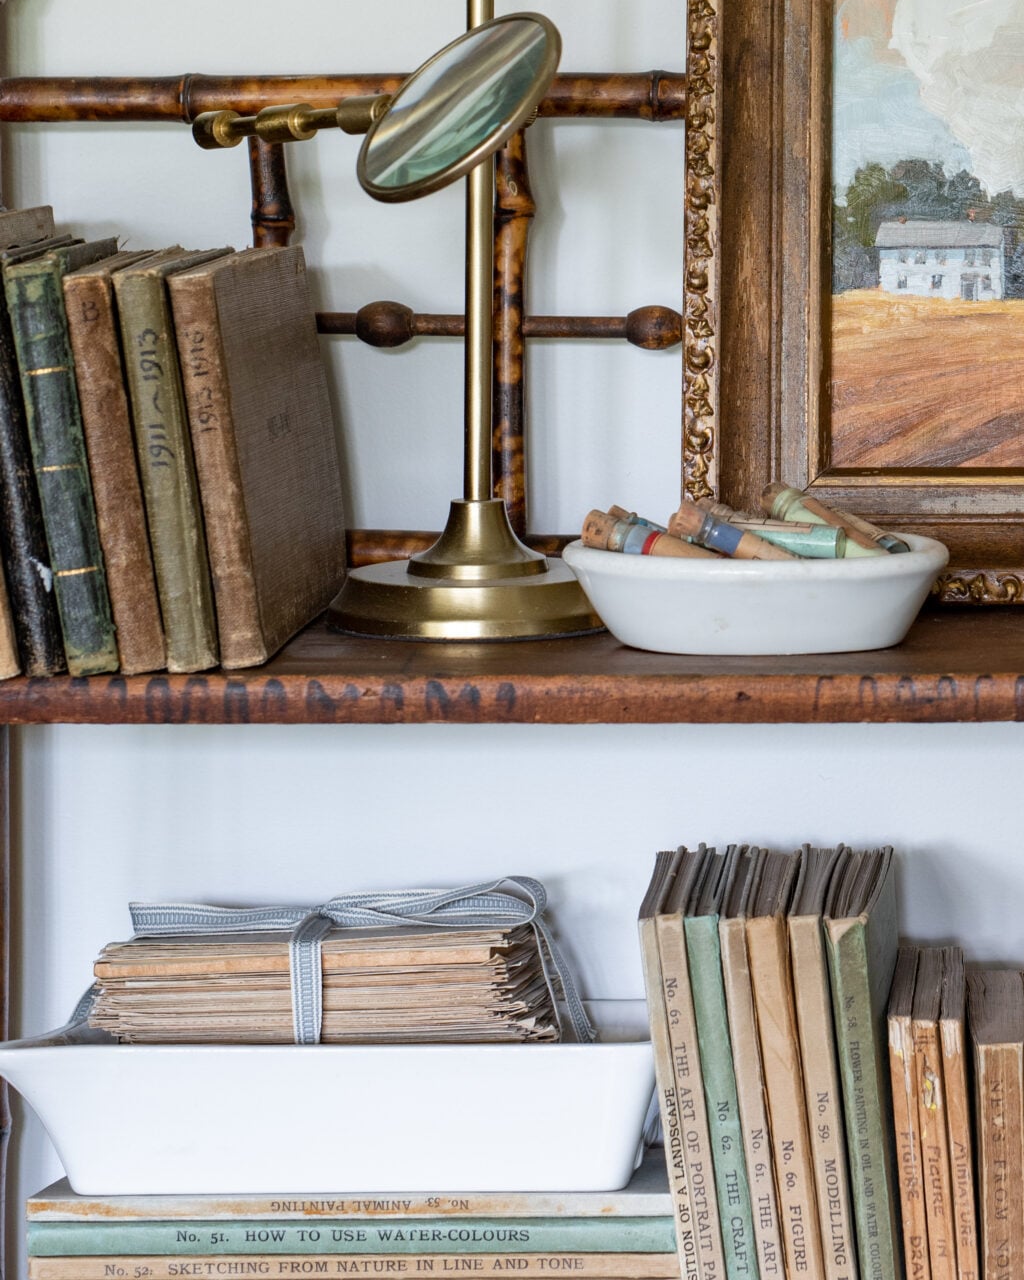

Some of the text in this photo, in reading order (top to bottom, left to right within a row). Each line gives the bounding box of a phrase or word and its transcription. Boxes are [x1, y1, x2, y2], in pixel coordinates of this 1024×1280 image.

[148, 423, 175, 468] 1911
[665, 977, 678, 1003] No.
[674, 1041, 690, 1079] THE
[849, 1040, 863, 1084] FLOWER
[680, 1087, 696, 1121] ART
[817, 1092, 829, 1117] No.
[854, 1086, 868, 1136] PAINTING
[664, 1088, 687, 1180] LANDSCAPE
[686, 1130, 701, 1154] OF
[817, 1125, 830, 1143] 59.
[859, 1138, 869, 1150] IN
[861, 1152, 872, 1172] OIL
[900, 1130, 920, 1201] FIGURE
[448, 1199, 470, 1210] No.
[677, 1186, 689, 1196] A
[717, 1101, 749, 1274] No. 62. THE CRAFT
[751, 1129, 778, 1274] No. 61. THE ART
[862, 1175, 874, 1198] AND
[927, 1145, 948, 1258] FIGURE IN
[954, 1141, 974, 1247] MINIATURE
[994, 1159, 1008, 1221] FROM
[270, 1200, 346, 1212] PAINTING
[352, 1199, 412, 1211] ANIMAL
[678, 1203, 691, 1223] OF
[690, 1162, 714, 1252] PORTRAIT
[782, 1141, 808, 1273] No. 60. FIGURE
[824, 1158, 847, 1266] MODELLING
[863, 1201, 878, 1239] WATER
[176, 1230, 531, 1245] No. 51. HOW TO USE WATER-COLOURS
[104, 1265, 129, 1276] No.
[167, 1262, 271, 1276] SKETCHING
[278, 1261, 330, 1274] FROM
[337, 1260, 409, 1273] NATURE
[416, 1260, 434, 1272] IN
[442, 1259, 485, 1272] LINE
[492, 1258, 529, 1271] AND
[538, 1257, 585, 1270] TONE
